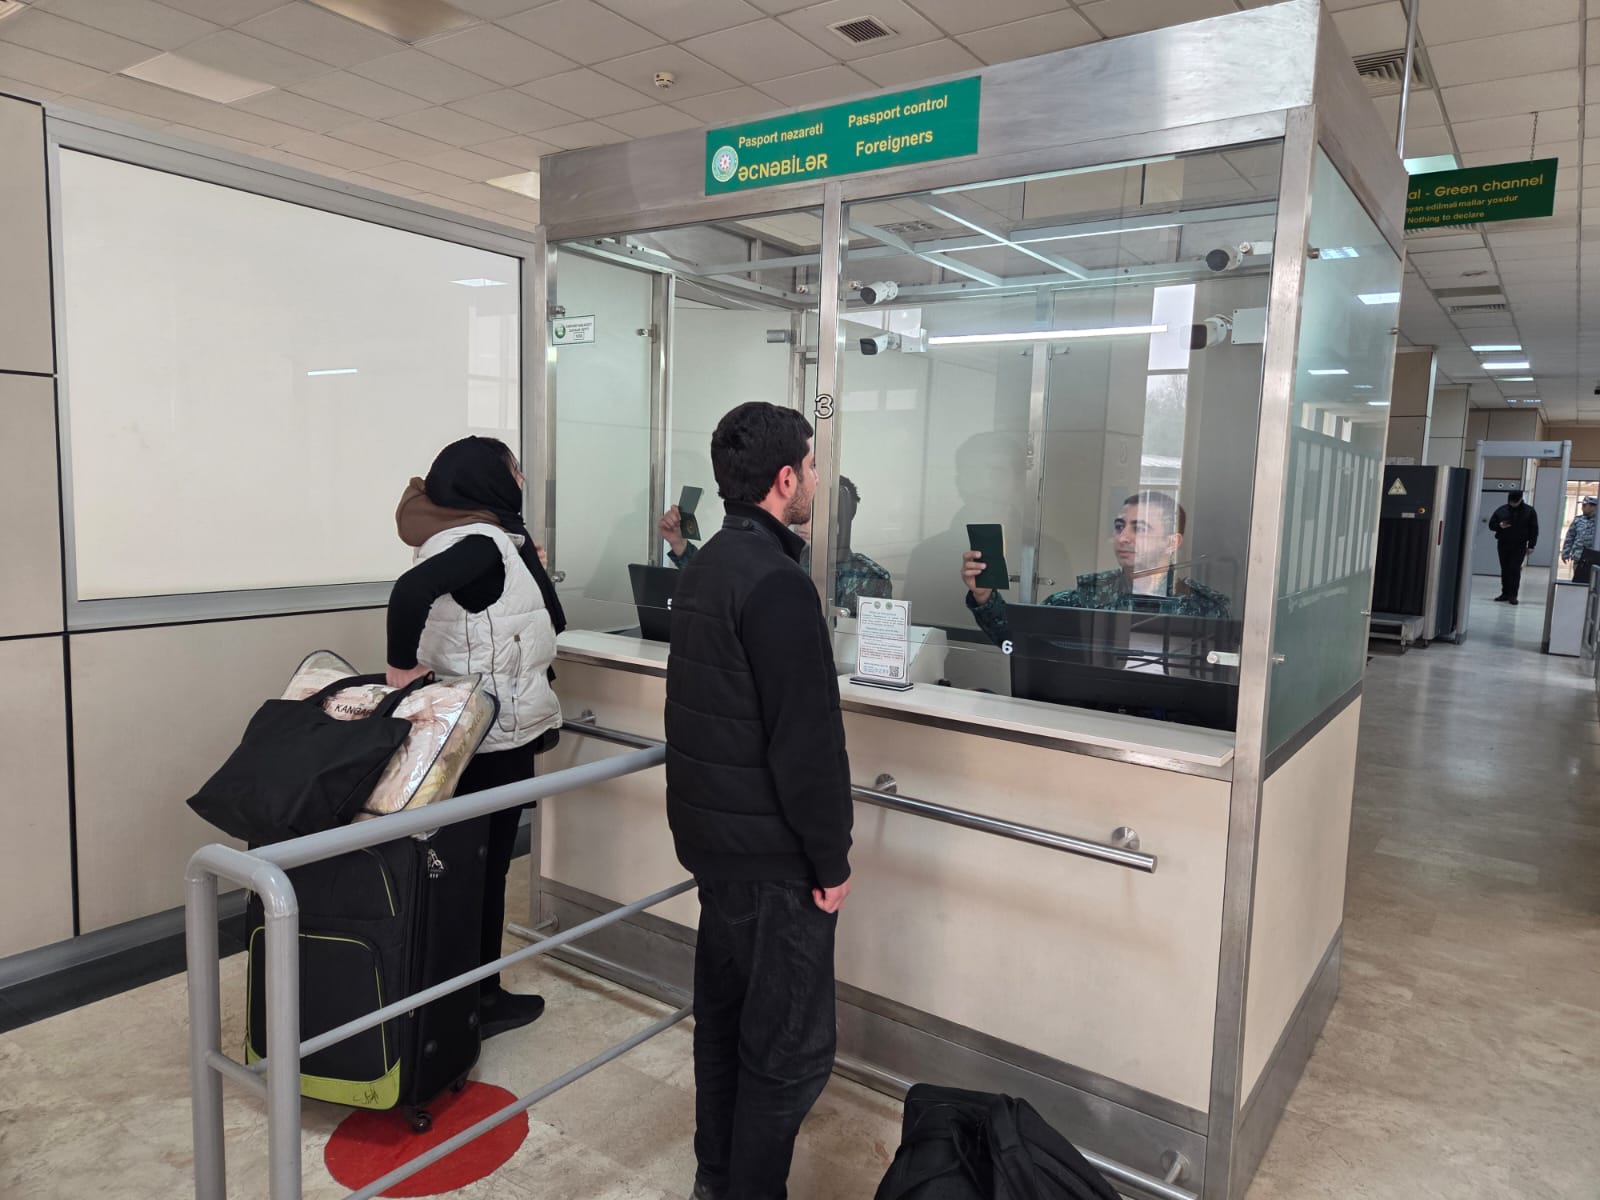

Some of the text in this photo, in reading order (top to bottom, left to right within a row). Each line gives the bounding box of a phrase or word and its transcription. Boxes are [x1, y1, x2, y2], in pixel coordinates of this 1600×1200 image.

[848, 94, 948, 128] Passport control
[738, 131, 778, 149] Pasport
[856, 130, 934, 157] Foreigners
[738, 153, 828, 181] ƏCNƏBİLƏR
[1434, 183, 1478, 197] Green
[1482, 174, 1544, 191] channel
[1408, 215, 1440, 224] Nothing
[1453, 211, 1485, 220] declare
[815, 394, 834, 419] 3
[1002, 640, 1013, 655] 6
